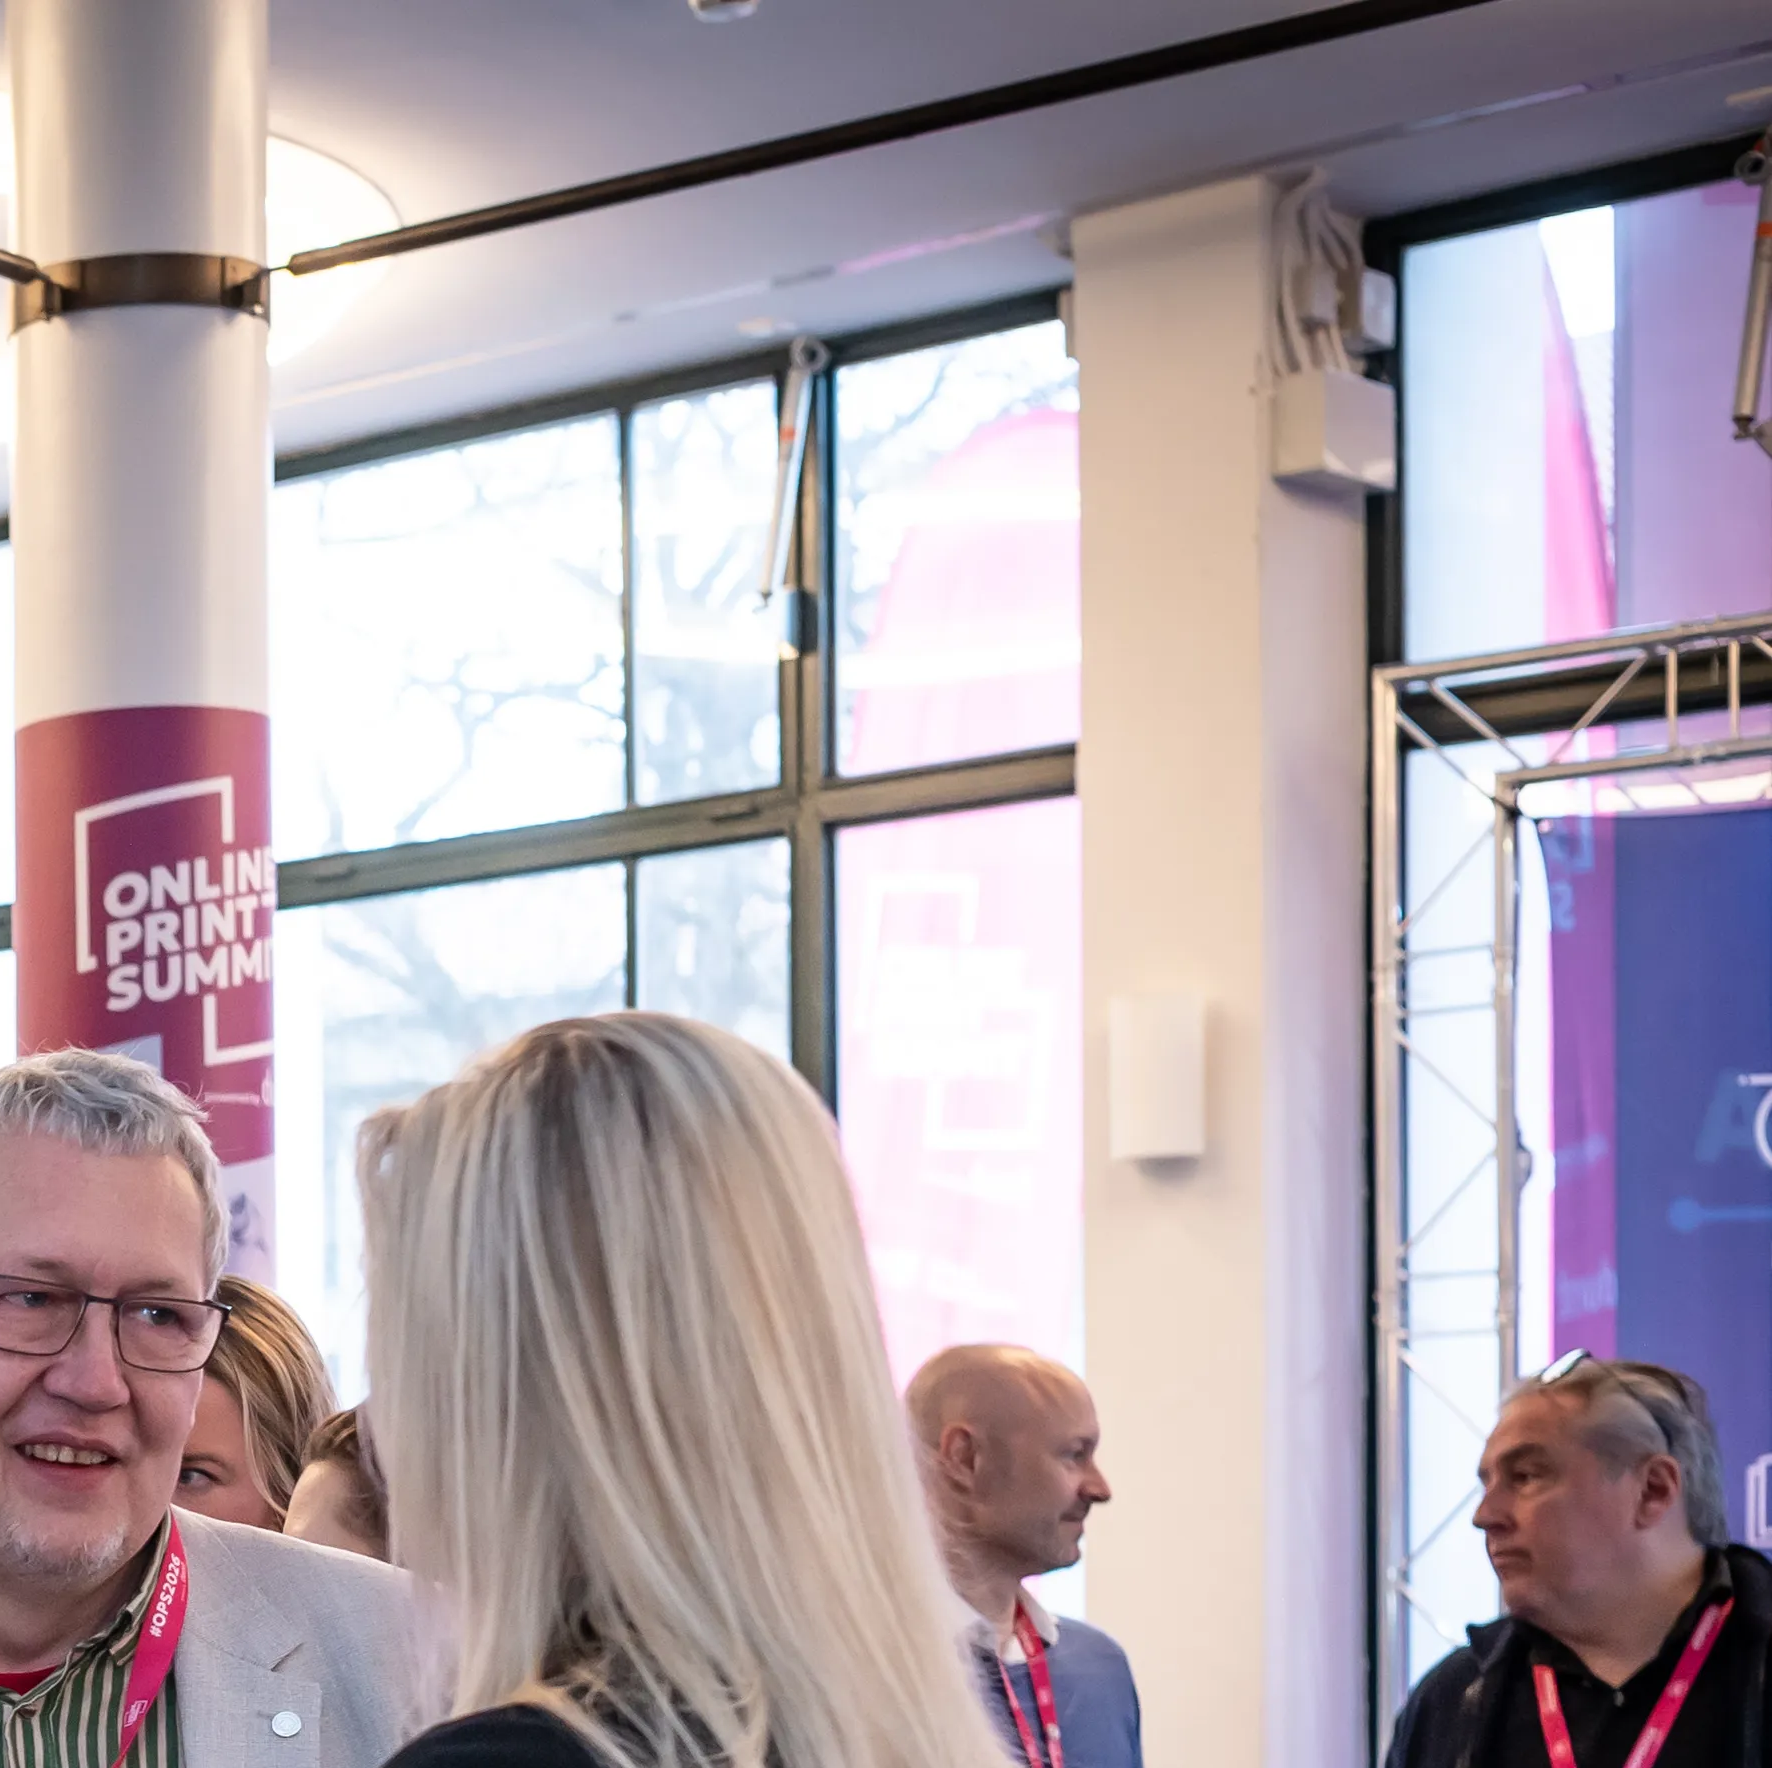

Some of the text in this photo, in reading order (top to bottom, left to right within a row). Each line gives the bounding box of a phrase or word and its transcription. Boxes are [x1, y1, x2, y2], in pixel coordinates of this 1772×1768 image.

[106, 894, 258, 966] PRINT
[105, 937, 273, 1013] SUMMI
[148, 1553, 181, 1638] #OPS2026
